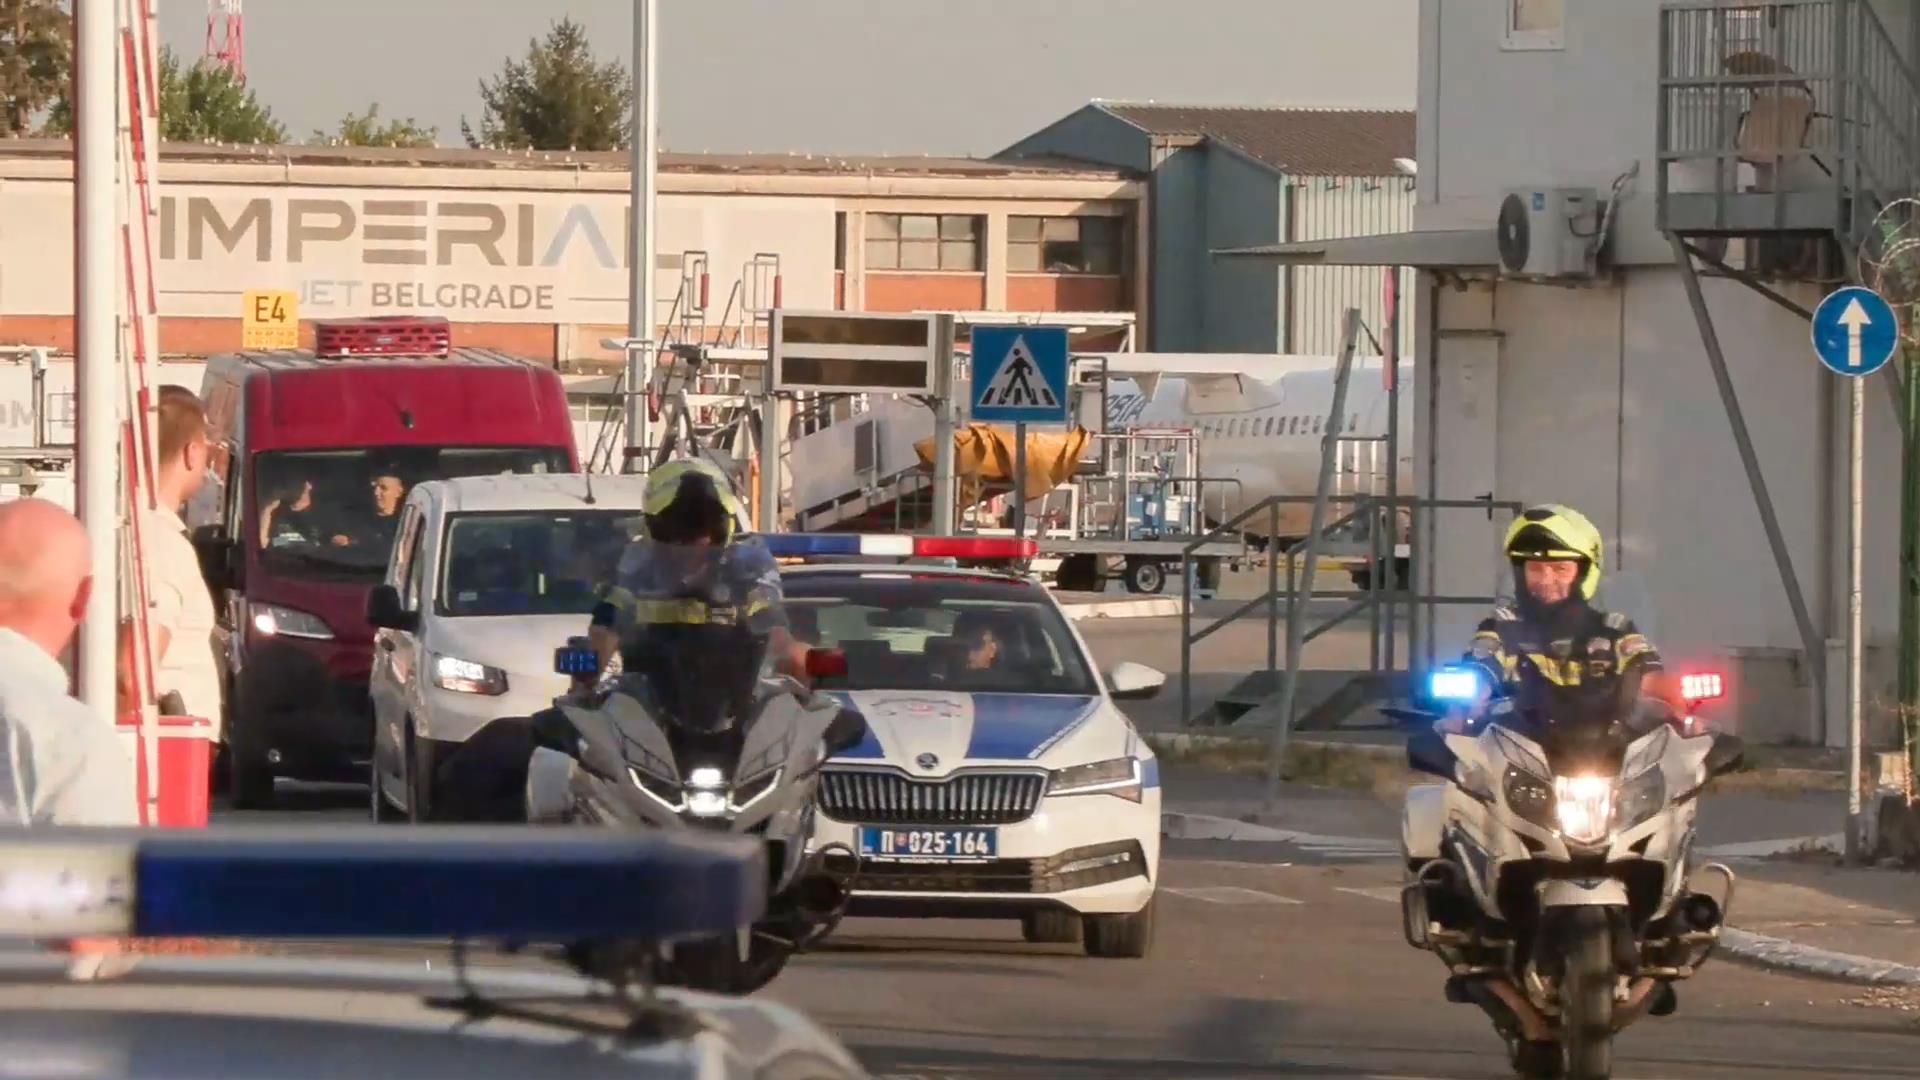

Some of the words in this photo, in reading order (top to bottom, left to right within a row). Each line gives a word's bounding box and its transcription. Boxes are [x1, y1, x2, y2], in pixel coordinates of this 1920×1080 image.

[298, 279, 363, 307] JET
[370, 282, 554, 310] BELGRADE
[255, 295, 287, 323] E4
[908, 830, 989, 855] 025-164
